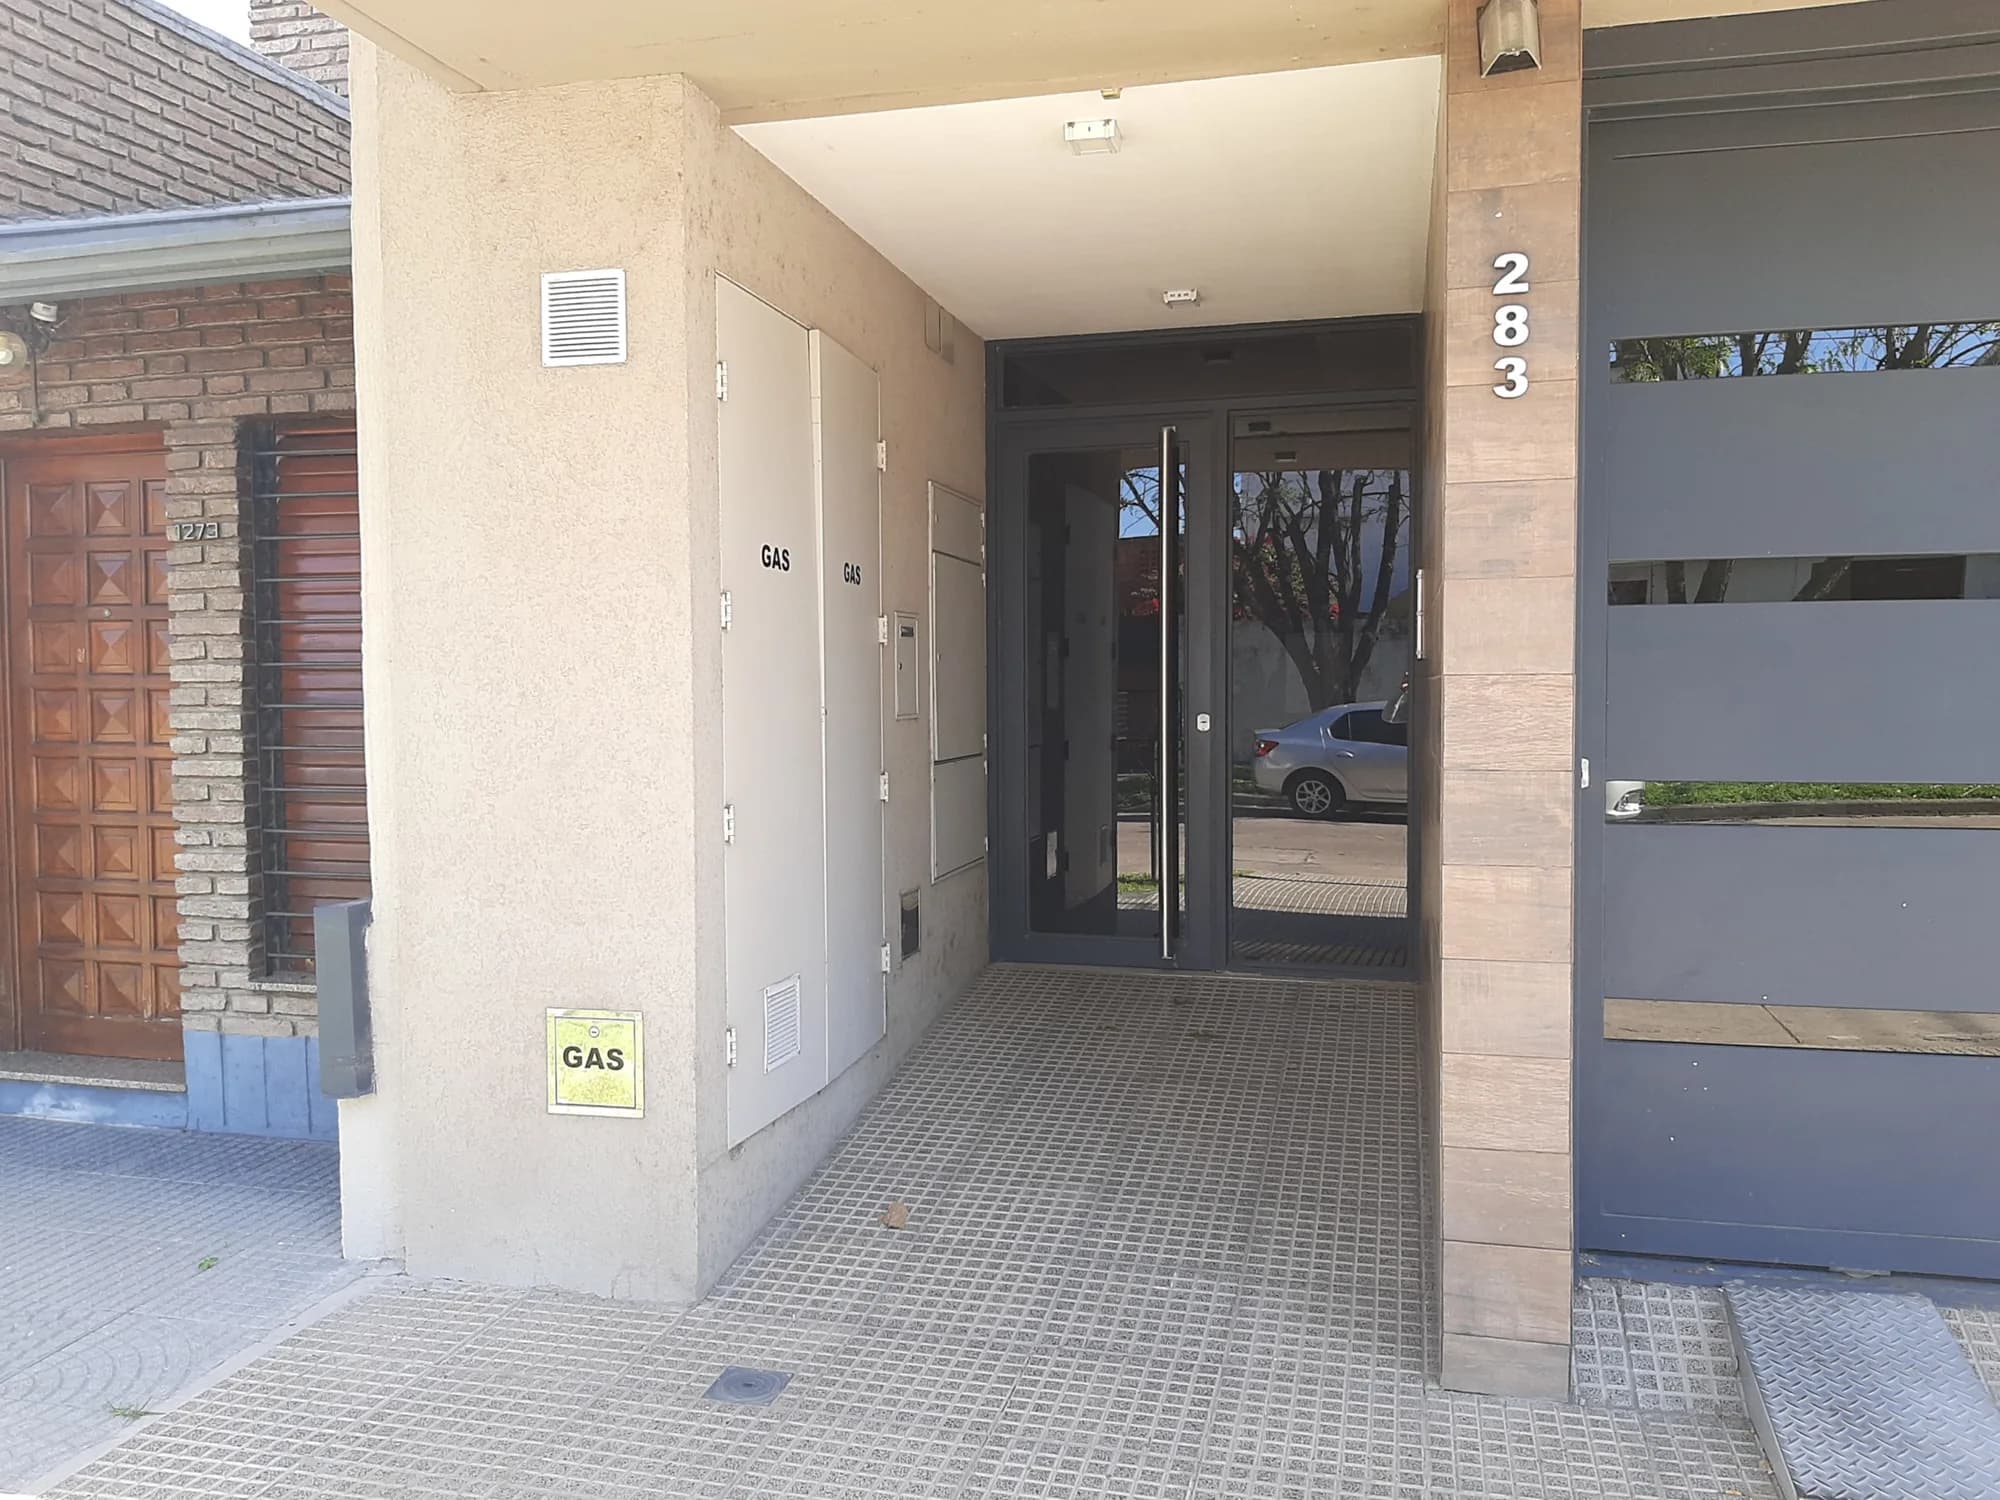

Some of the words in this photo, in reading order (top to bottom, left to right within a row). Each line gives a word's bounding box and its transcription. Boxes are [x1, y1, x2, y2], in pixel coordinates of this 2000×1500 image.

[1492, 252, 1530, 399] 283
[175, 522, 218, 540] 1273
[761, 543, 790, 571] GAS
[843, 562, 861, 585] GAS
[562, 1046, 625, 1071] GAS
